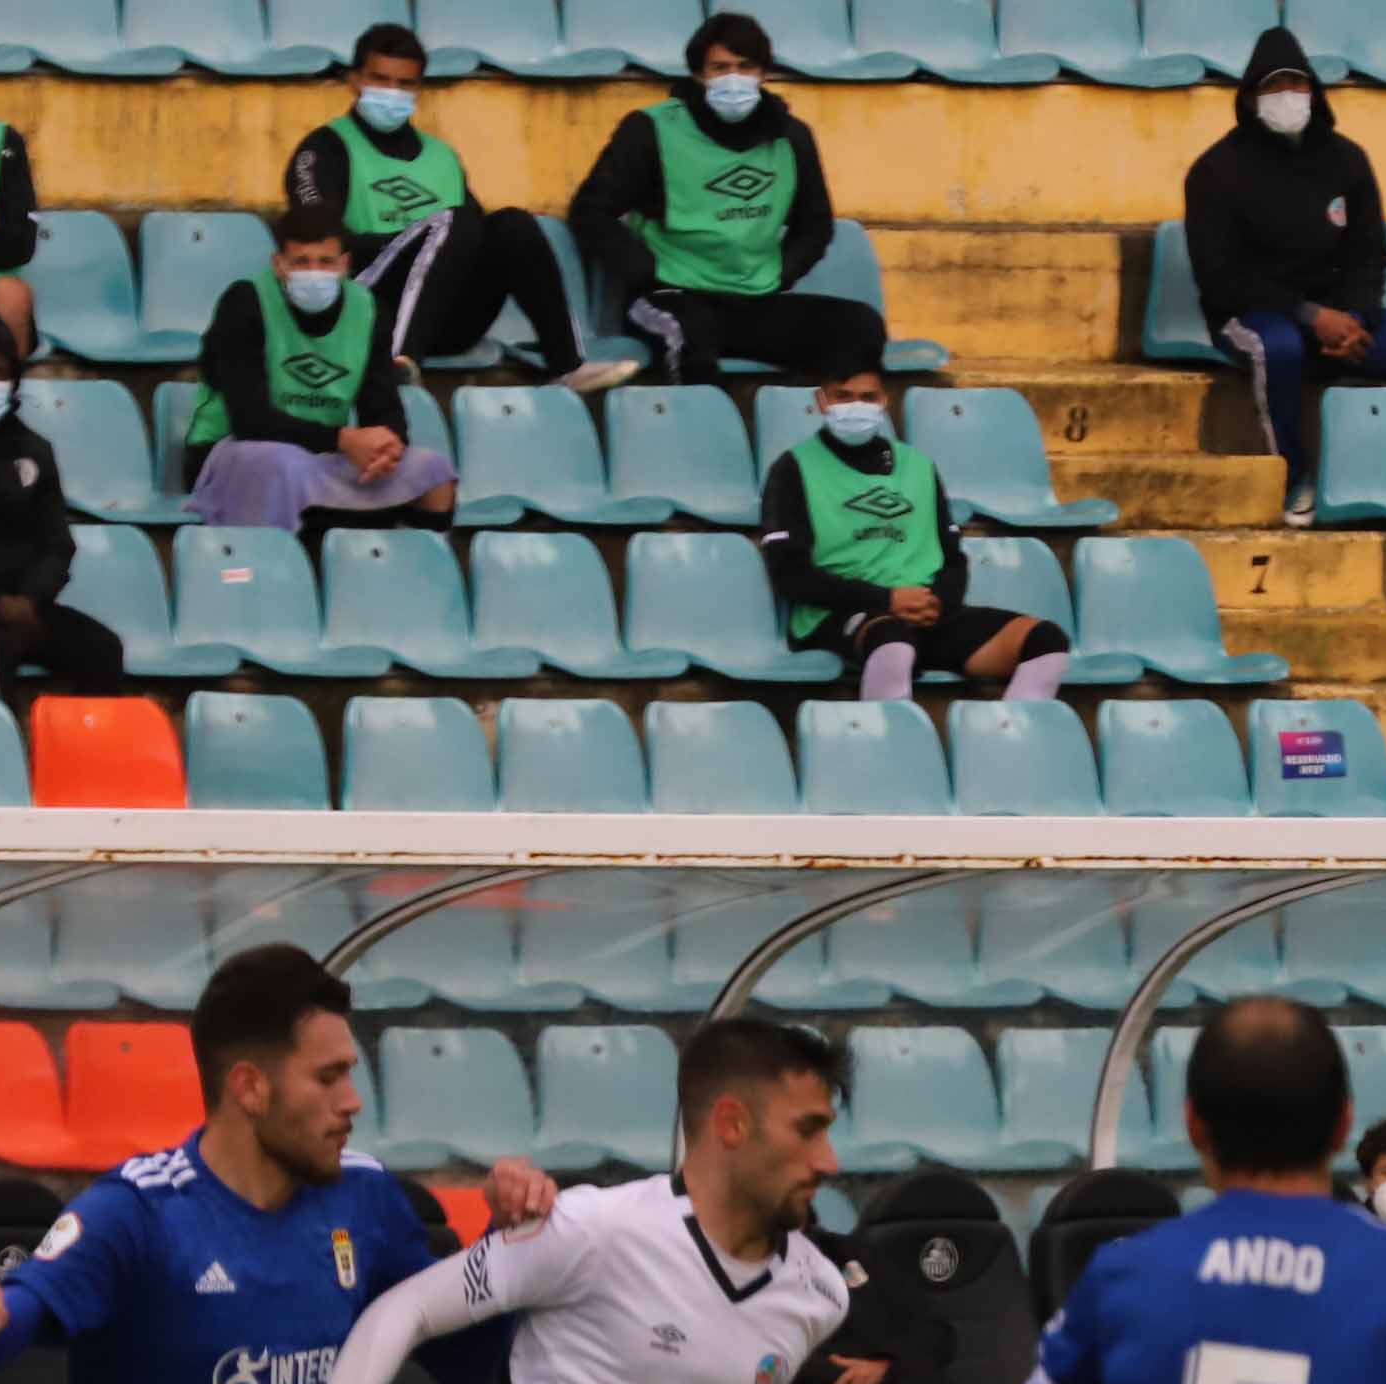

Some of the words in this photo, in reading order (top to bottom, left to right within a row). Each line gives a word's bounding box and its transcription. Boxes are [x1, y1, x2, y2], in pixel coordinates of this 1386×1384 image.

[1064, 407, 1089, 443] 8
[1249, 554, 1271, 595] 7
[1197, 1236, 1326, 1295] ANDO
